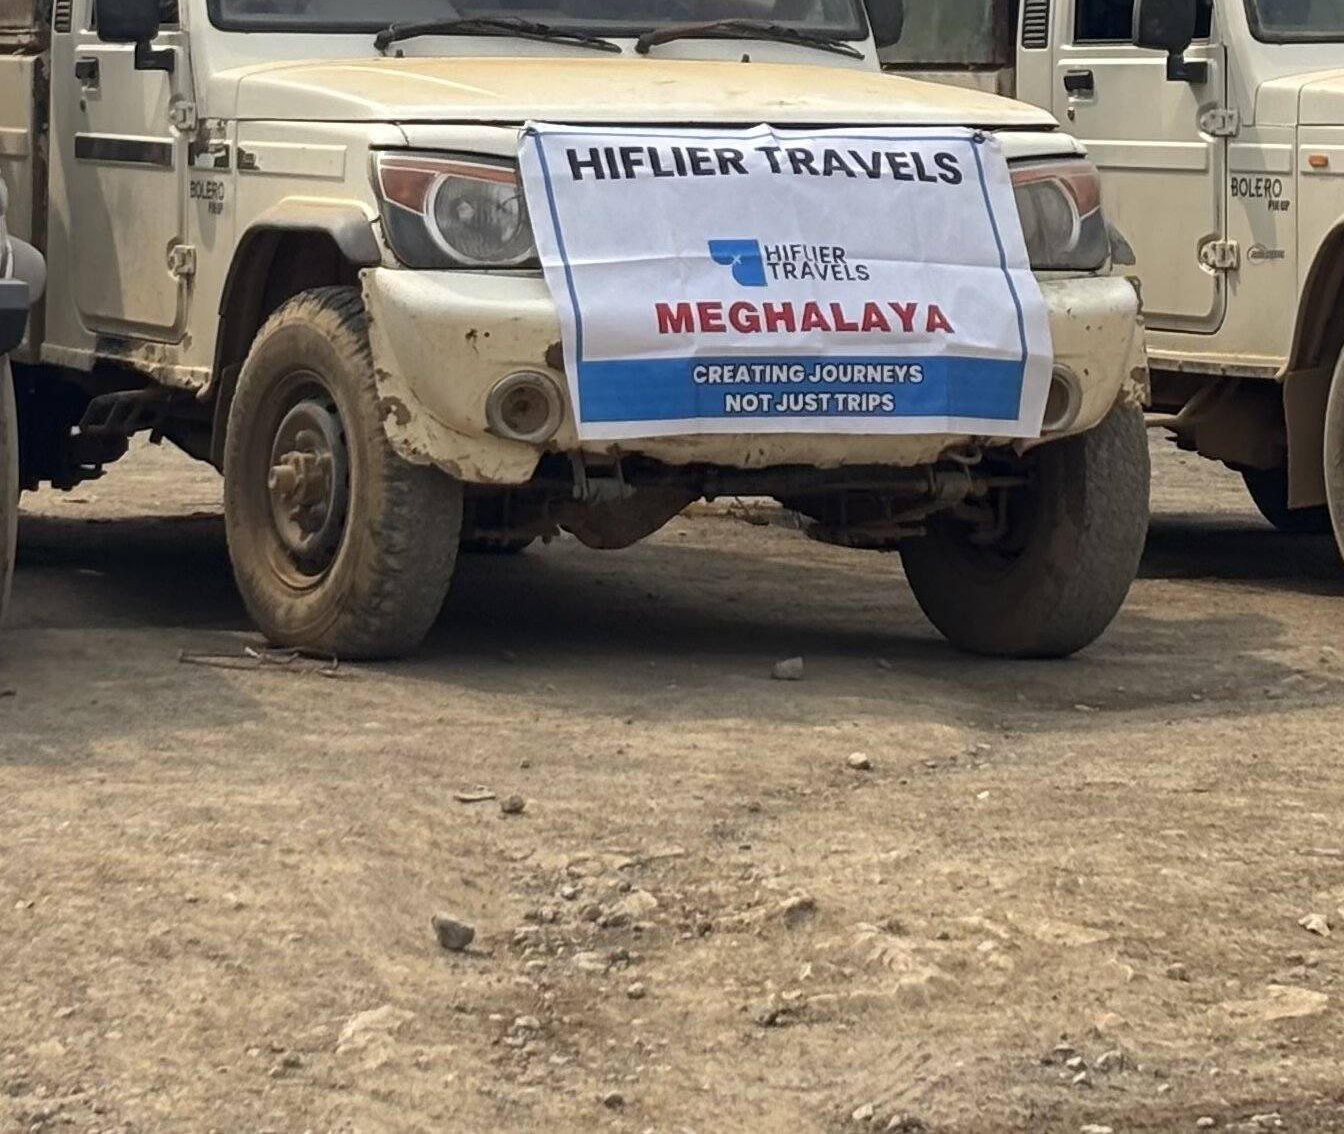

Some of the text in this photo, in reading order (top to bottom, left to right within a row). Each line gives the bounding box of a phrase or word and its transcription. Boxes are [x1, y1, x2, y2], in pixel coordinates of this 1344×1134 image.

[566, 145, 963, 185] HIFLIER TRAVELS
[190, 180, 224, 200] BOLERO
[1231, 177, 1282, 198] BOLERO
[765, 244, 846, 265] HIFLIER
[767, 262, 870, 282] TRAVELS
[655, 301, 956, 334] MEGHALAYA
[693, 365, 923, 384] CREATING JOURNEYS
[725, 393, 894, 413] NOT JUST TRIPS
